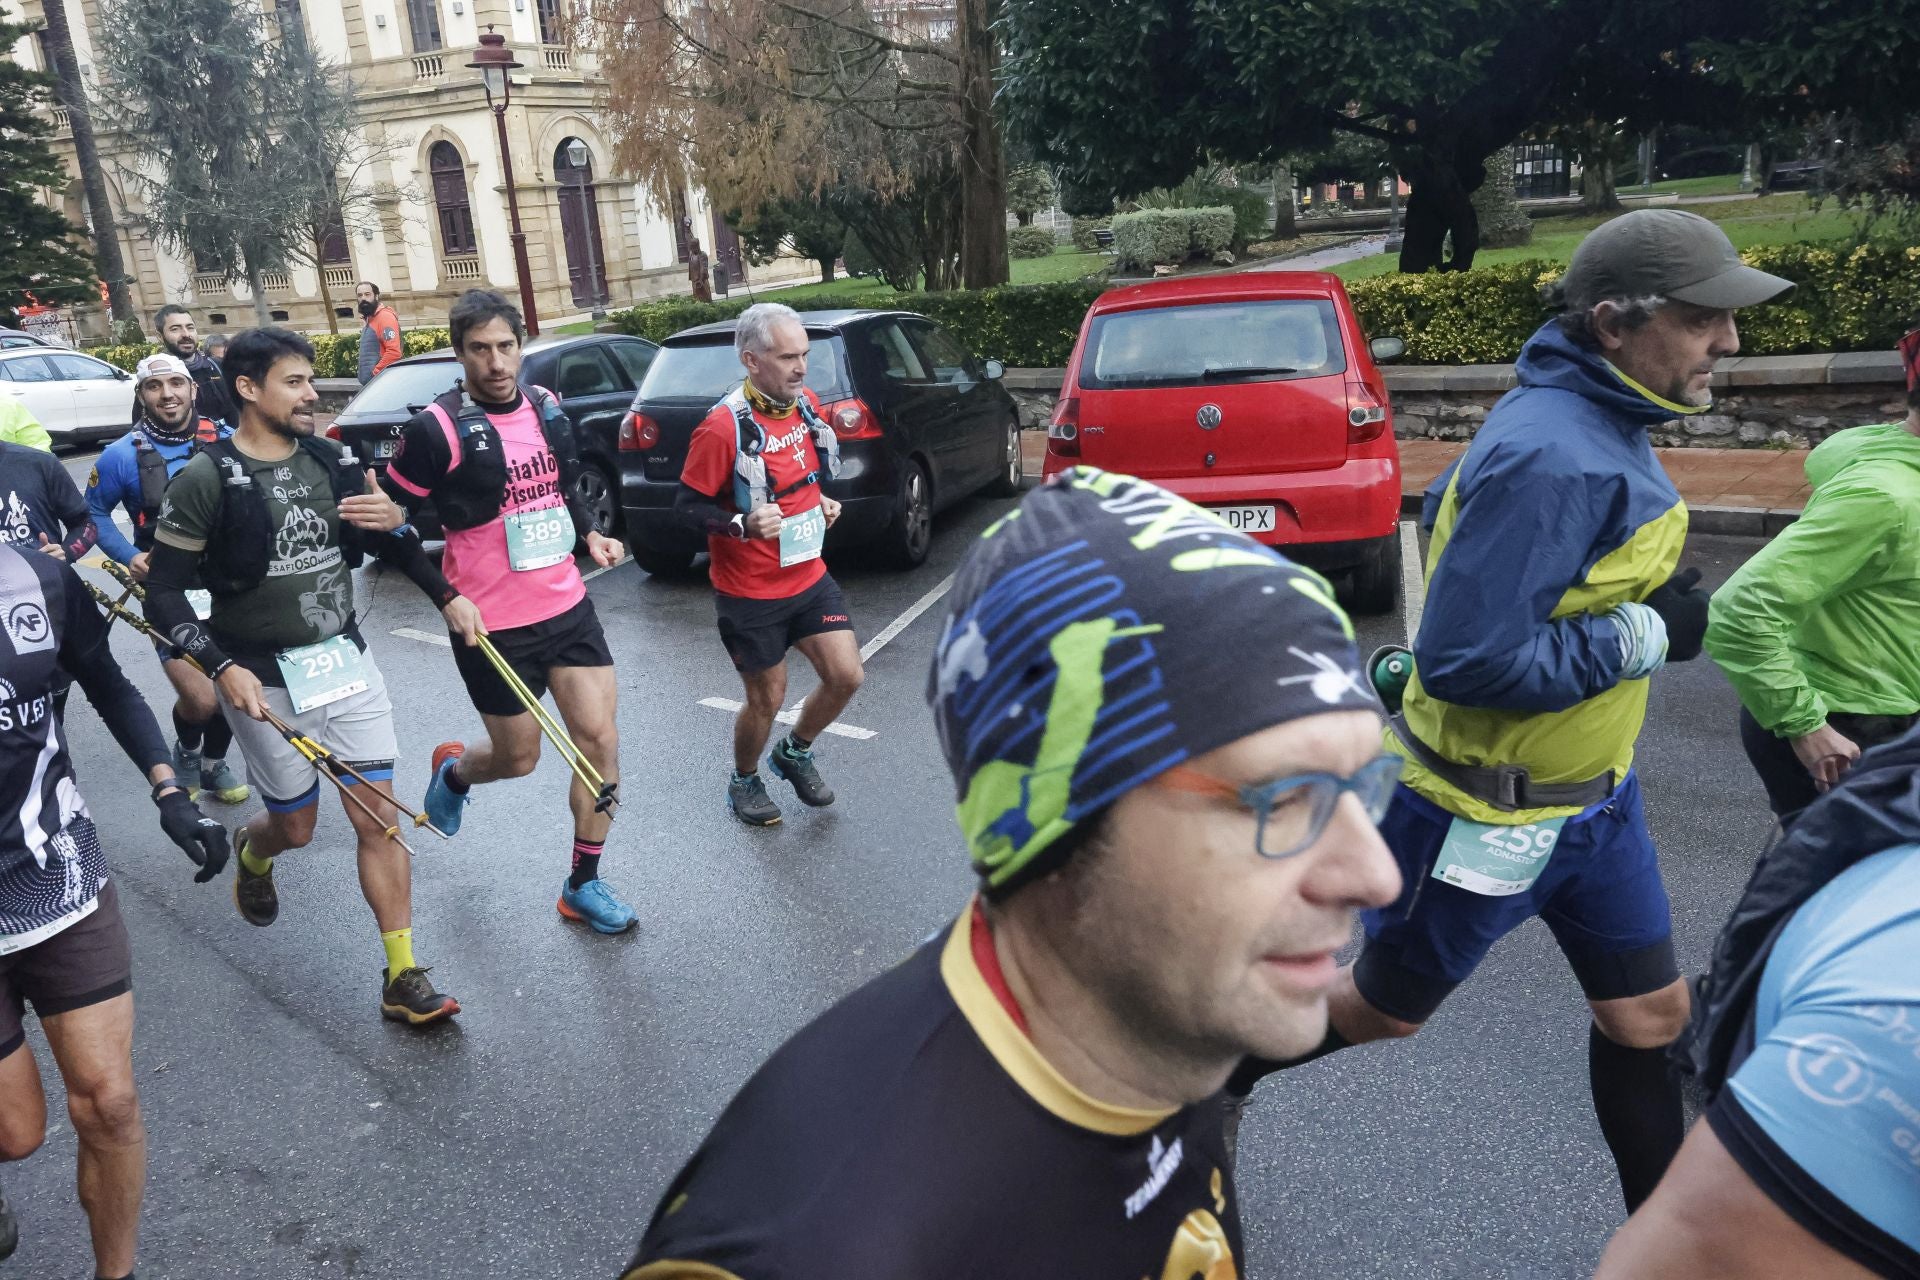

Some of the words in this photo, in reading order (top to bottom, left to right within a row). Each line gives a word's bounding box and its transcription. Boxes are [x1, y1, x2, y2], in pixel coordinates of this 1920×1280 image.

[764, 422, 809, 454] 4Amigo
[1084, 426, 1105, 434] FOX
[521, 519, 562, 543] 389
[792, 519, 818, 541] 281
[1229, 510, 1269, 529] DPX
[301, 648, 345, 680] 291
[1480, 824, 1558, 859] 259
